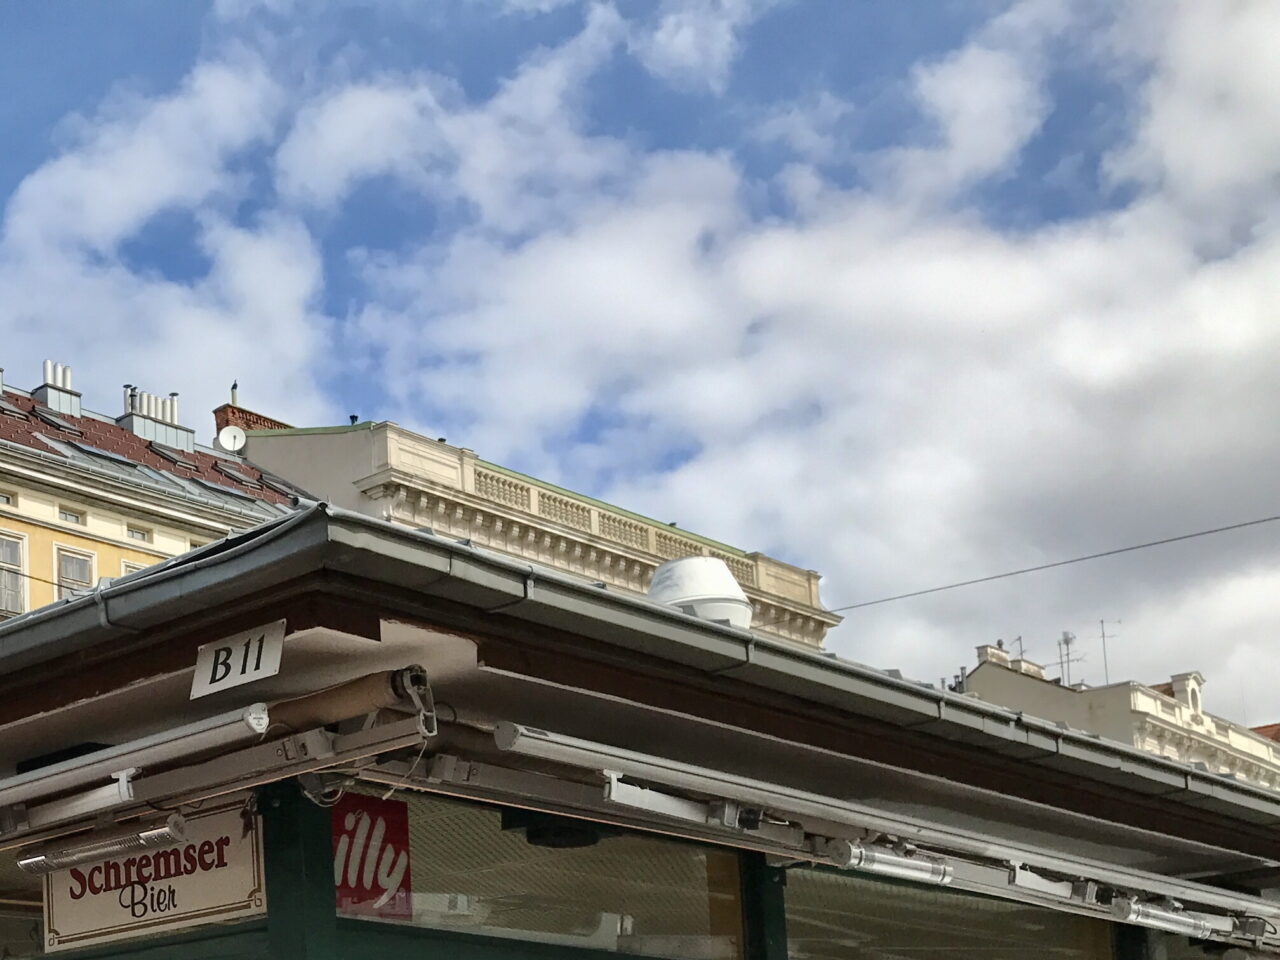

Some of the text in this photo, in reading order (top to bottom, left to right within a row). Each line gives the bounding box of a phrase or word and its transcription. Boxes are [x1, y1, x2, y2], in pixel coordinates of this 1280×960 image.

[69, 834, 231, 899] Schremser
[334, 809, 409, 909] illy
[119, 881, 177, 918] Bier
